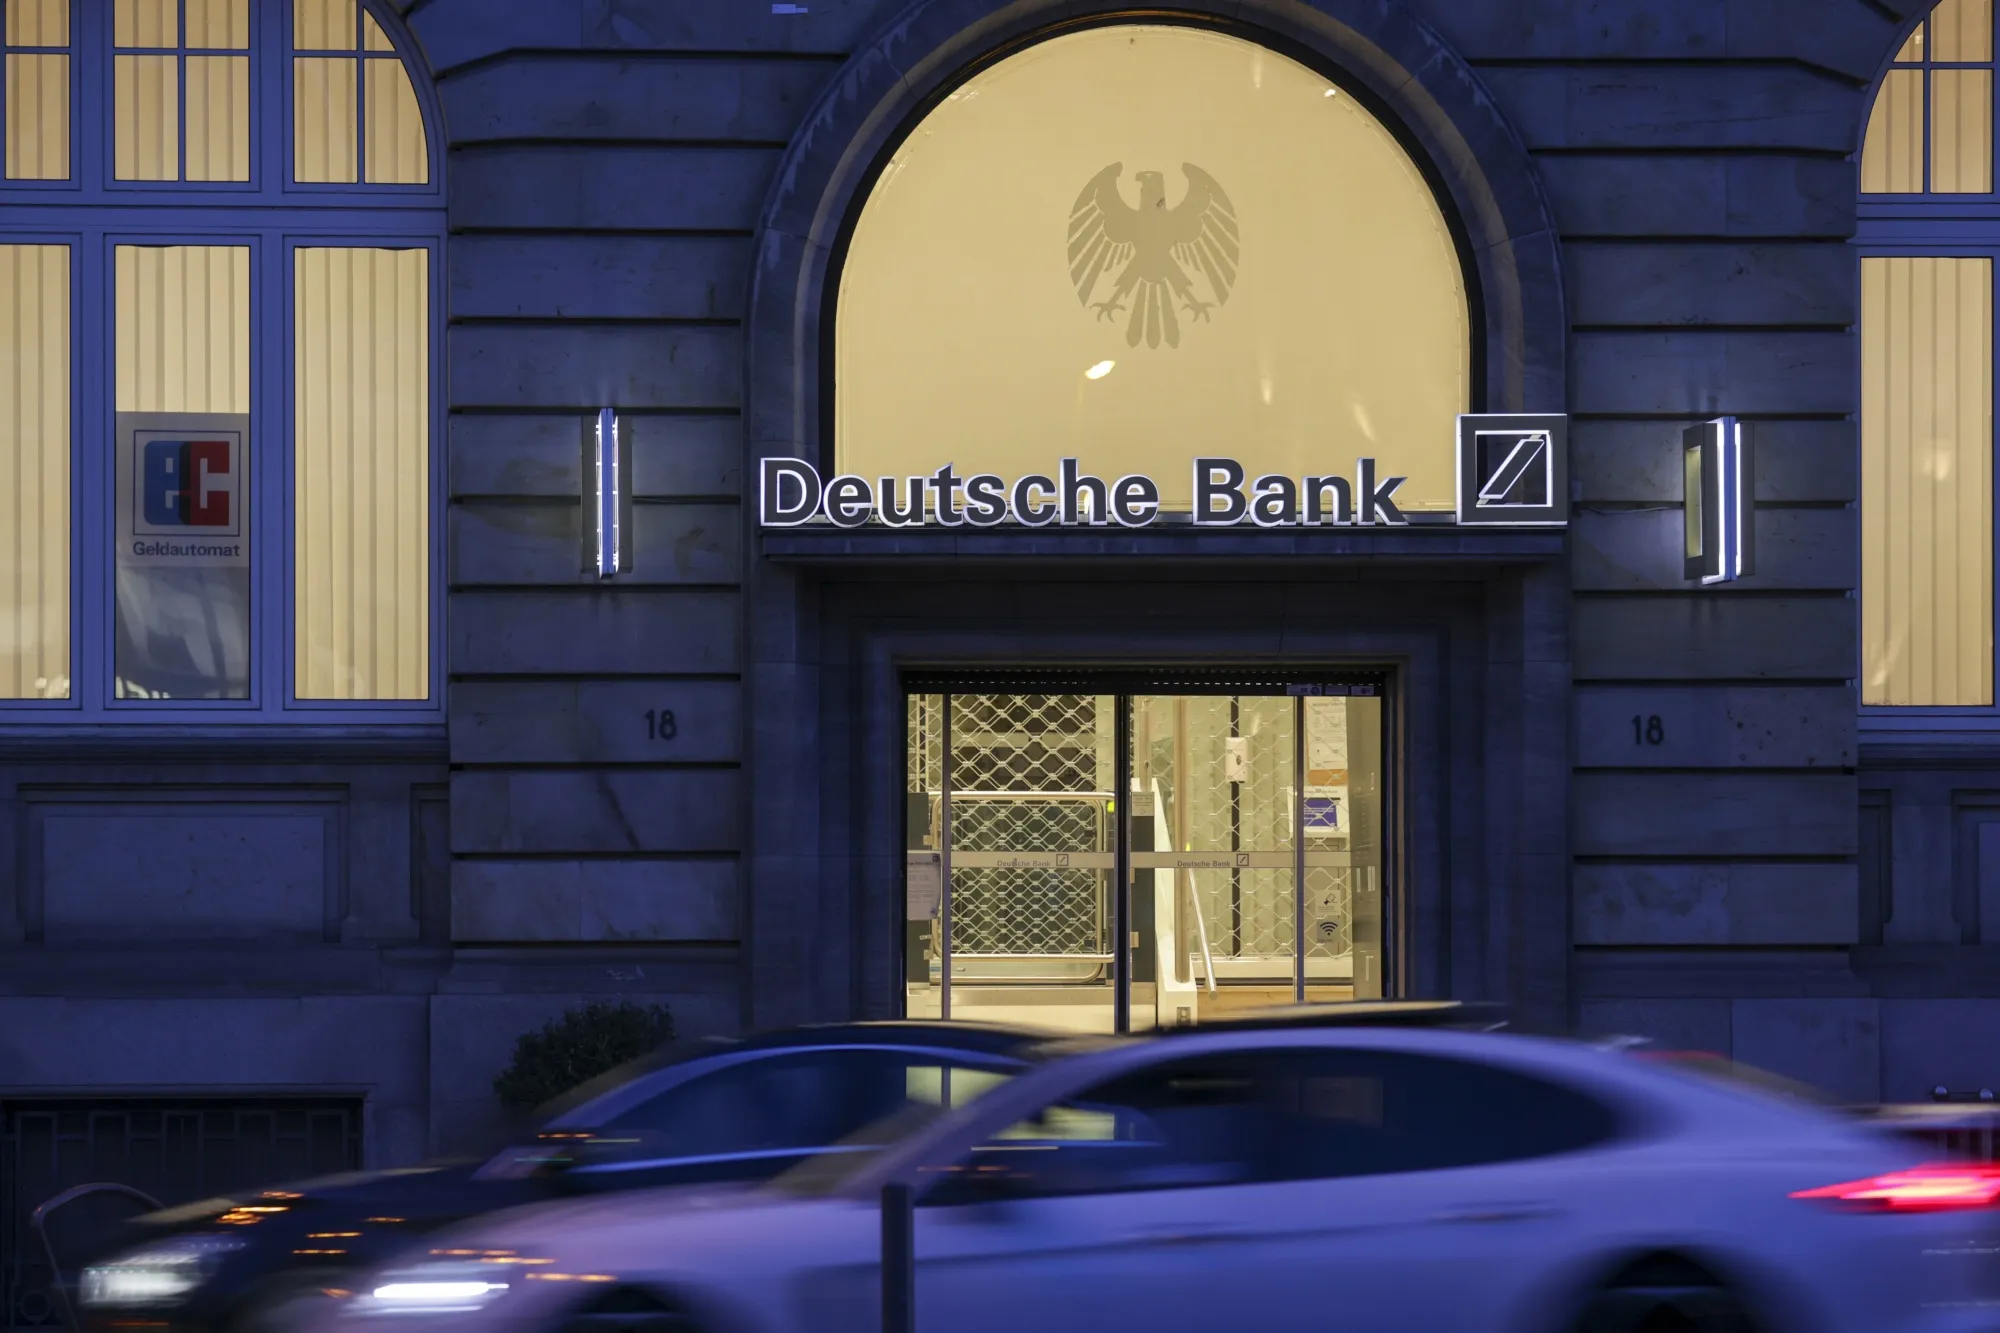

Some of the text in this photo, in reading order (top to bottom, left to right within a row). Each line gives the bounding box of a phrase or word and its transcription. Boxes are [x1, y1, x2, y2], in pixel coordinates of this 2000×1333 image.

[760, 457, 1409, 528] Deutsche Bank
[132, 541, 241, 557] Geldautomat
[644, 709, 678, 741] 18
[1631, 714, 1664, 746] 18
